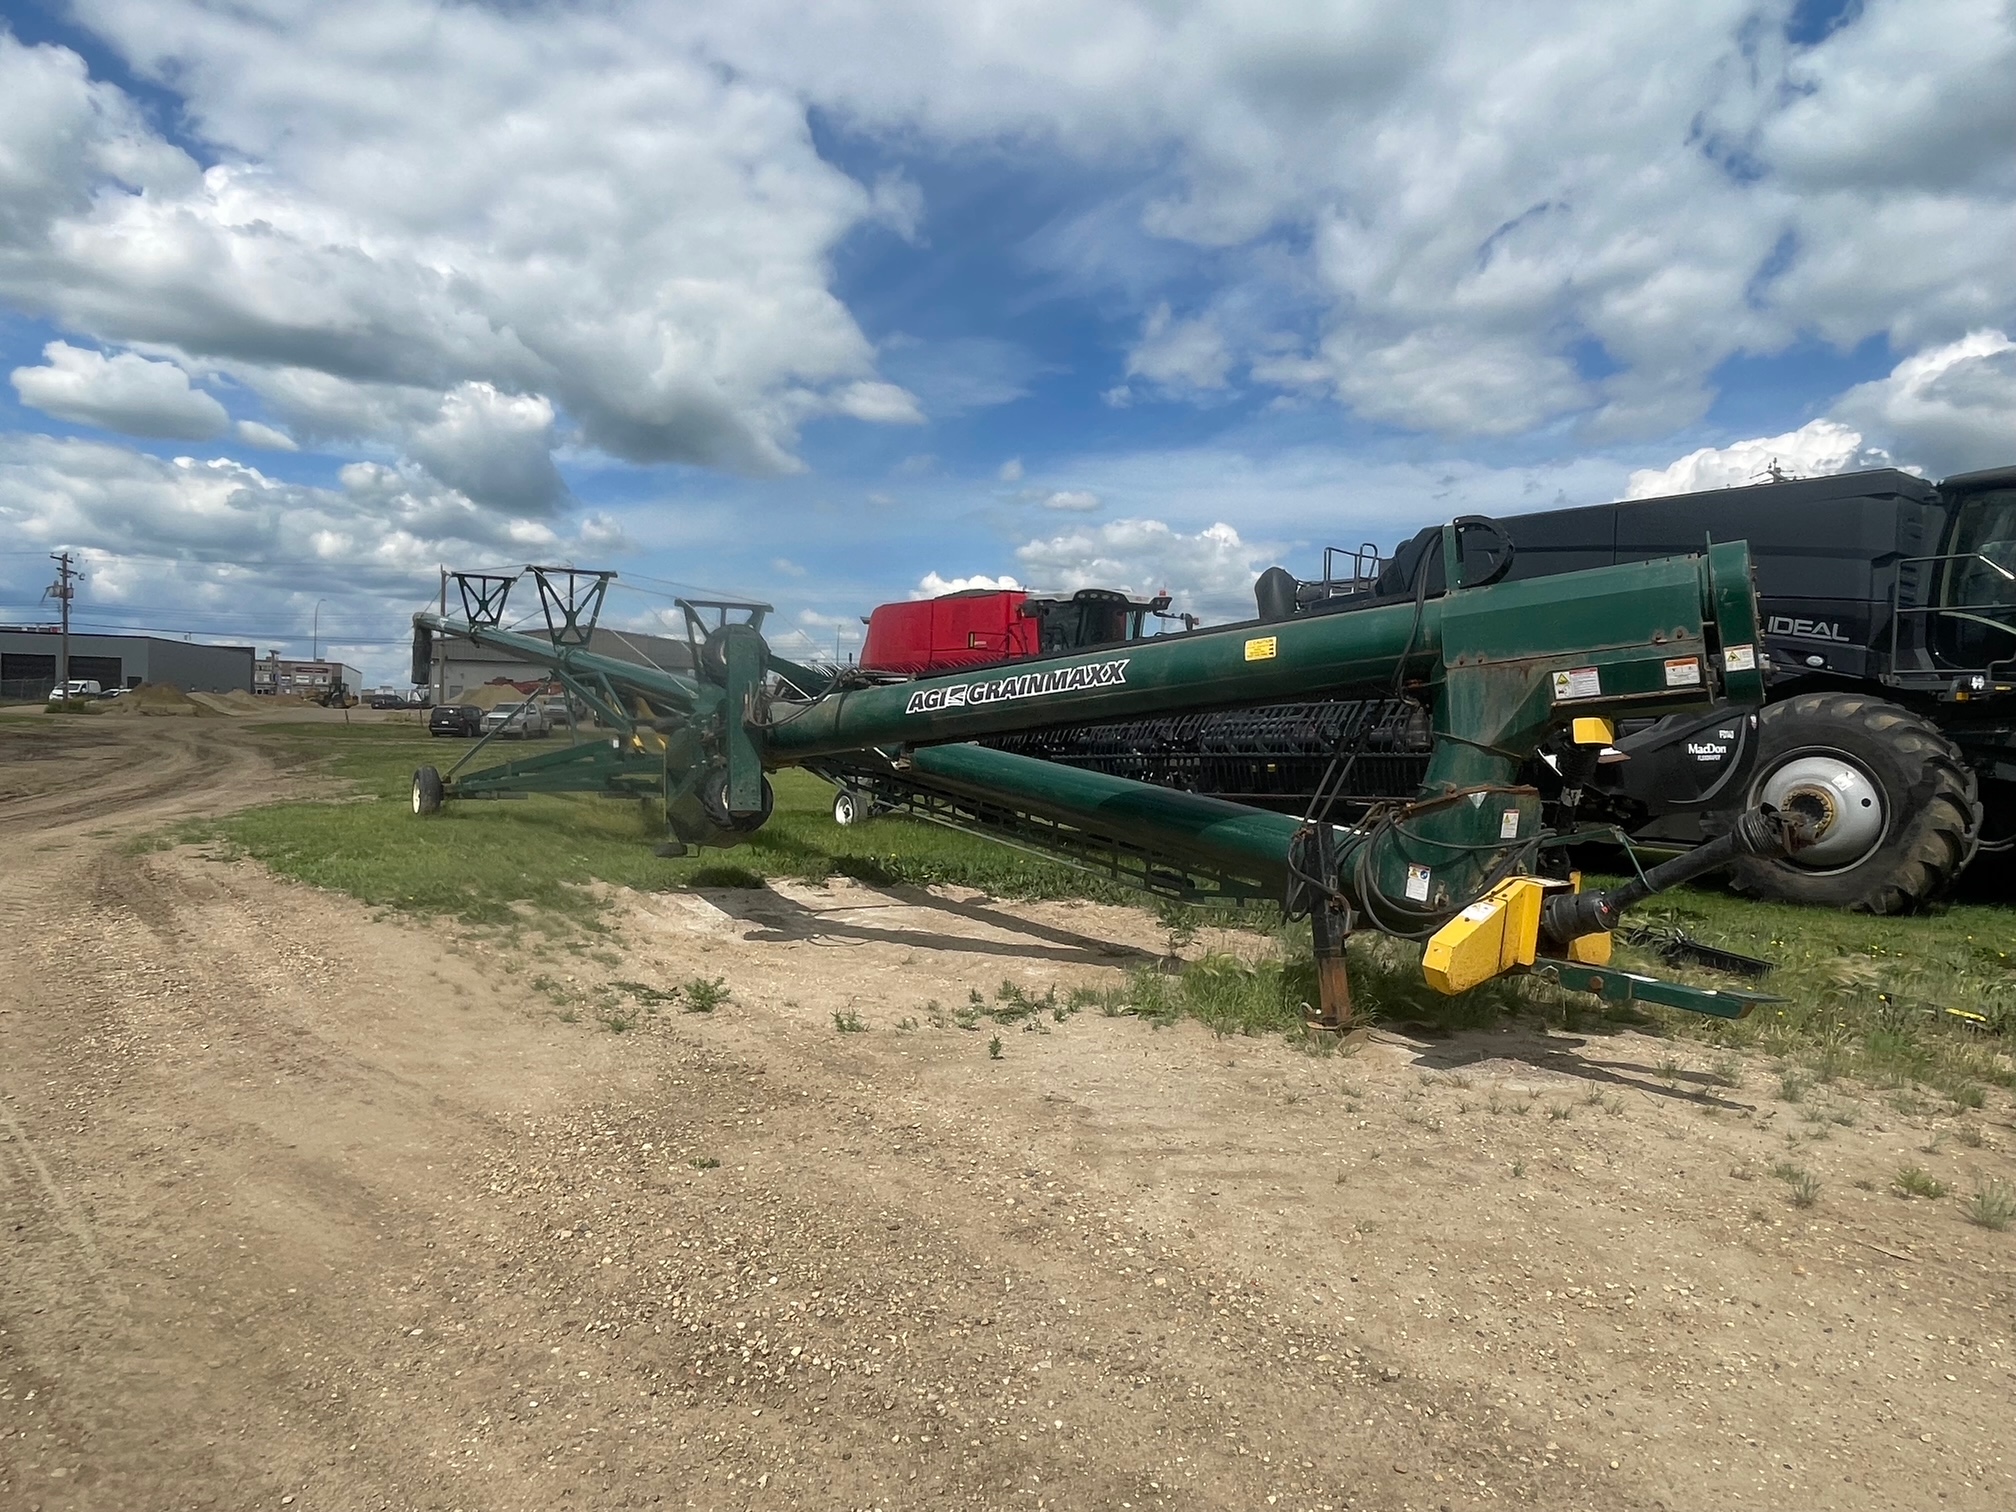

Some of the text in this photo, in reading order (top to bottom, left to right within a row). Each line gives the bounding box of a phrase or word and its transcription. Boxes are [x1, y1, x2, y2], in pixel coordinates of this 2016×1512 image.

[1768, 616, 1849, 641] IDEAL
[906, 659, 1130, 714] AGI GRAINMAXX
[1688, 743, 1726, 754] MacDon
